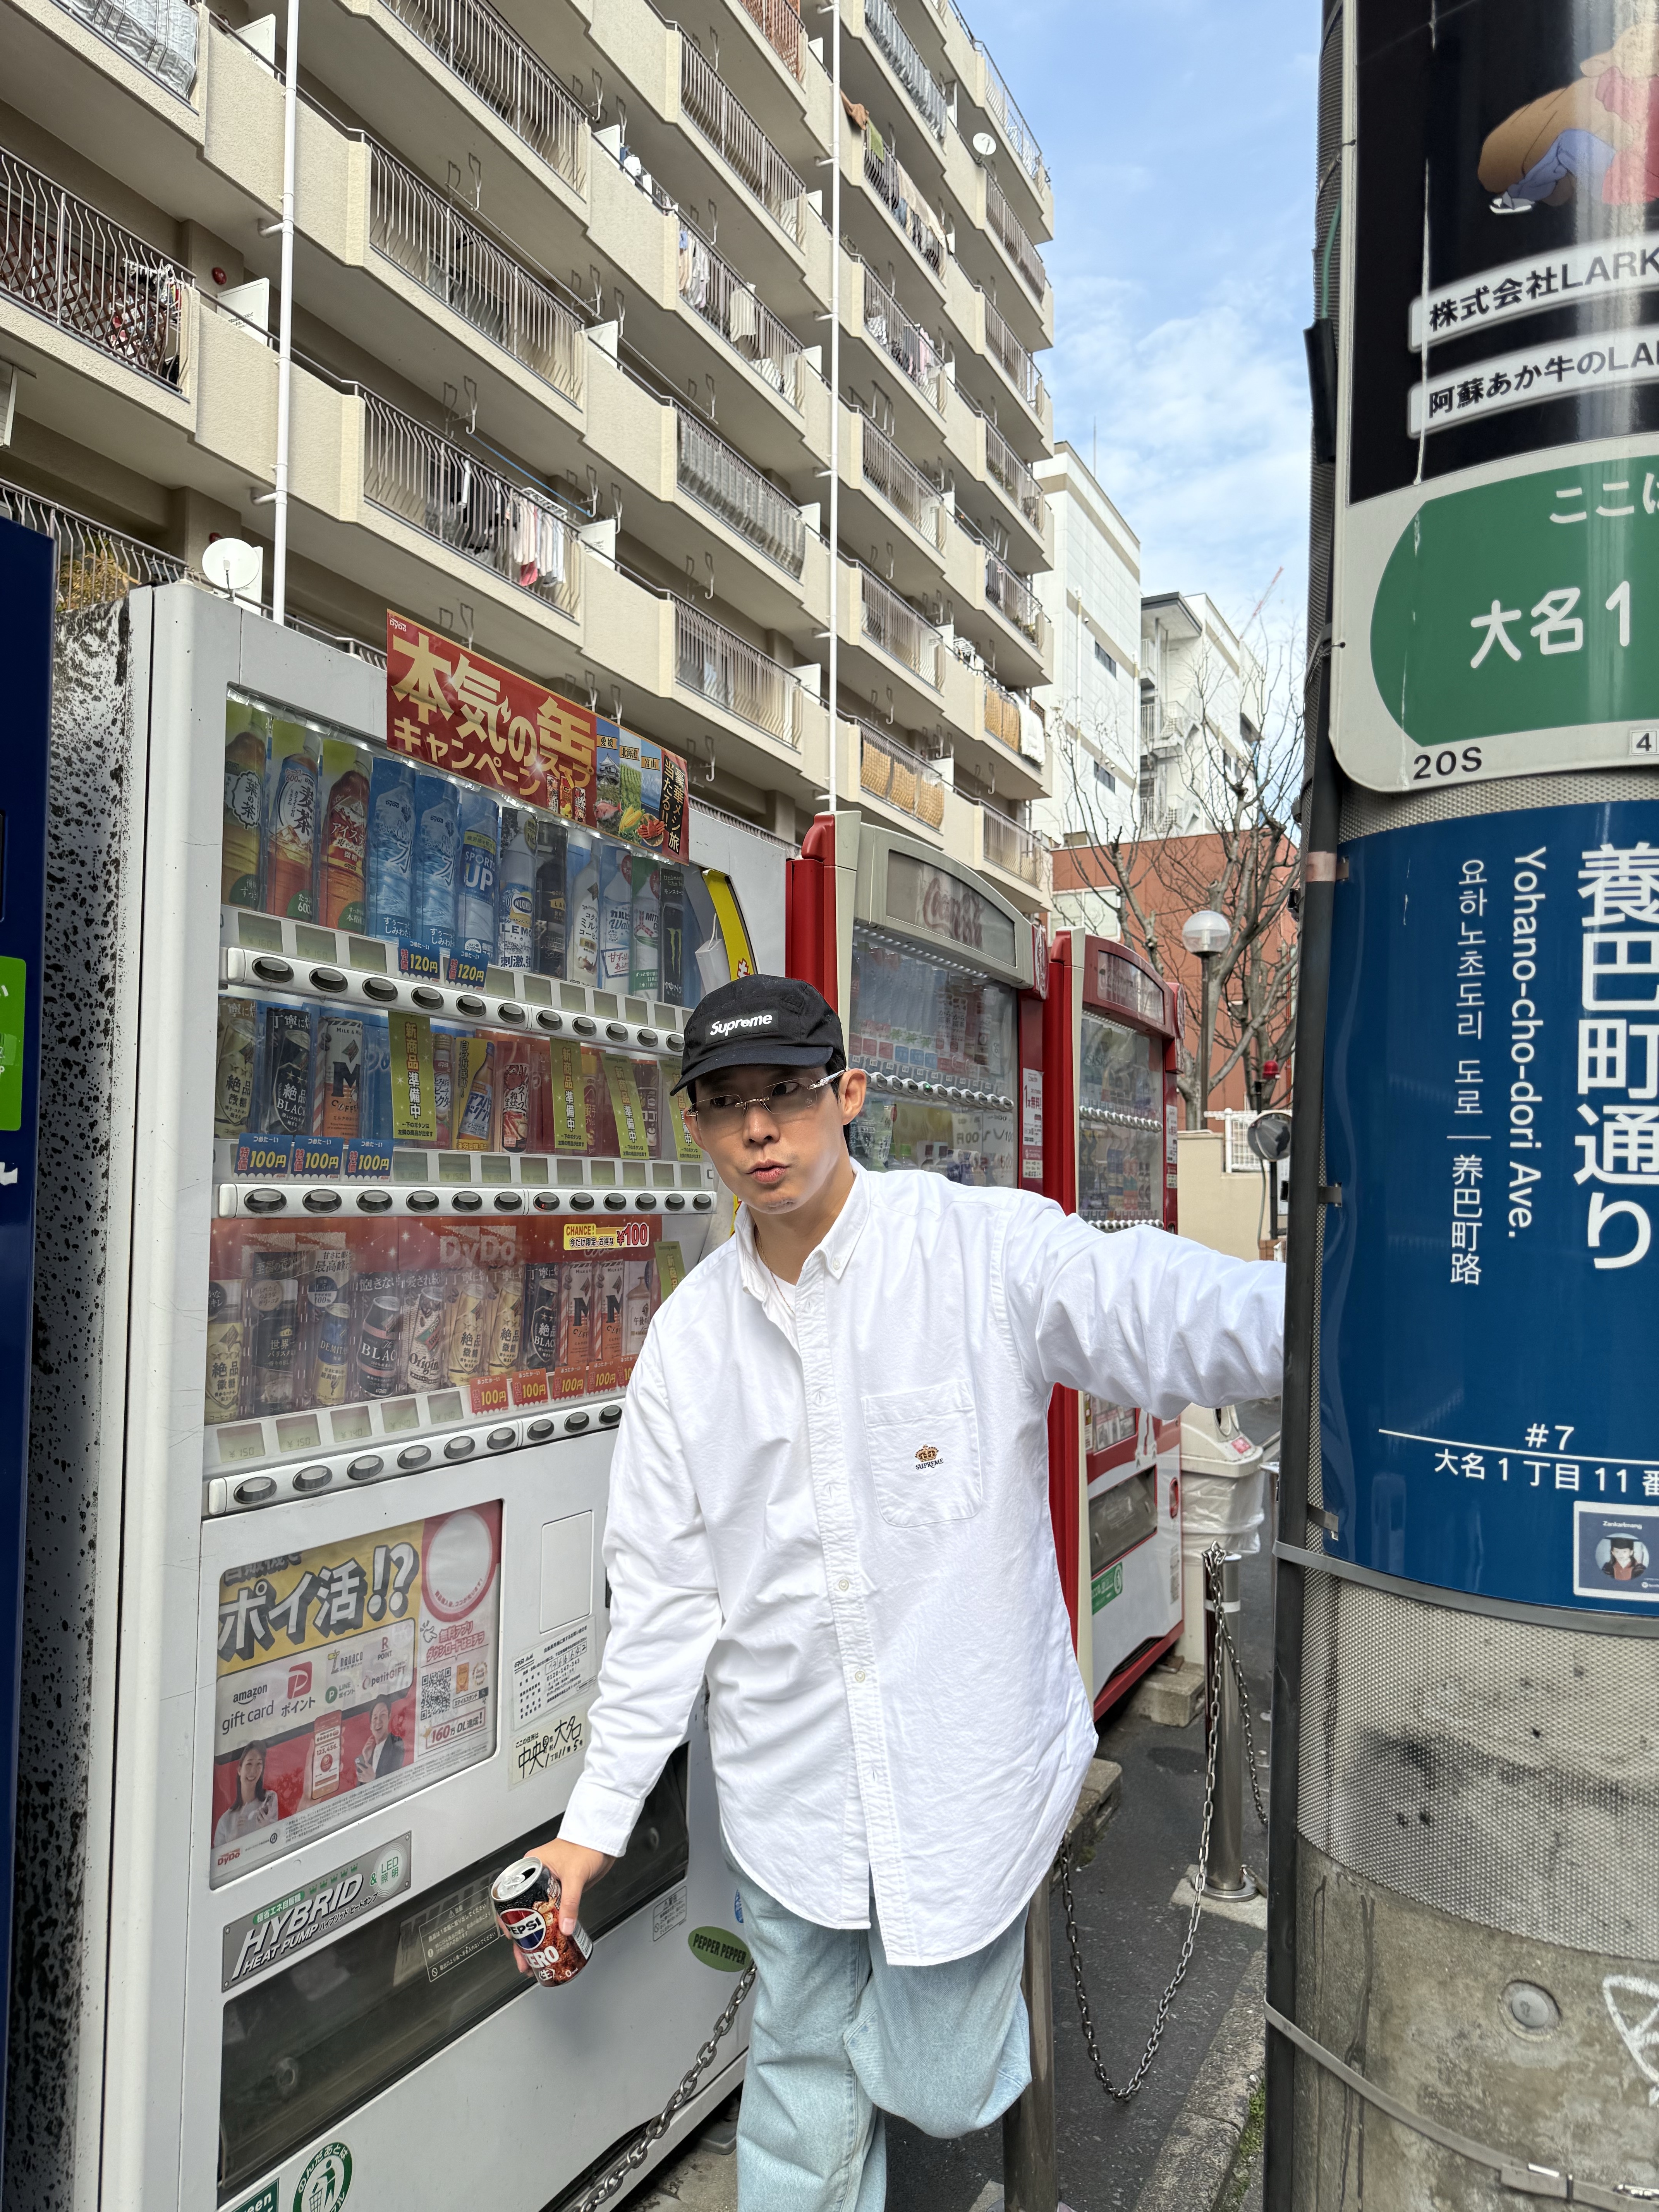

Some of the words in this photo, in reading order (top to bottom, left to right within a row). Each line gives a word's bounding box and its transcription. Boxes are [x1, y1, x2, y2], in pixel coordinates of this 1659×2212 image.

[1428, 340, 1659, 419] 阿蘇あか牛のLA
[390, 617, 407, 632] DyDo
[1470, 580, 1630, 669] 大名1
[392, 632, 595, 770] 本気の缶
[1636, 733, 1652, 752] 4
[394, 717, 540, 796] キャンペーン
[644, 758, 656, 768] 富山
[1413, 746, 1482, 780] 20S
[385, 799, 400, 809] DyDo
[430, 815, 443, 824] DyDo
[465, 863, 493, 891] UP
[1456, 859, 1487, 1041] 요하노초도리
[410, 954, 438, 973] 120円
[458, 964, 484, 982] 120円
[1509, 847, 1546, 1149] Yohano-cho-dori
[710, 1014, 773, 1036] Supreme
[1574, 841, 1659, 1270] 養巴町通り
[405, 1021, 422, 1120] 新商品準備中
[562, 1047, 575, 1132] 新商品準備中
[1454, 1059, 1484, 1115] 도로
[614, 1066, 637, 1144] 新商品準備中
[250, 1151, 286, 1168] 100円
[306, 1152, 338, 1169] 100円
[359, 1155, 389, 1171] 100円
[1508, 1161, 1542, 1238] Ave.
[566, 1225, 594, 1236] CHANCE!
[562, 1378, 583, 1393] 100円
[596, 1372, 616, 1387] 100円
[481, 1389, 507, 1406] 100円
[522, 1383, 546, 1399] 100円
[1525, 1423, 1574, 1450] #7
[915, 1458, 944, 1470] SUPREME
[219, 1542, 418, 1656] ポイ活!?
[340, 1651, 363, 1667] nanaco
[378, 1650, 392, 1660] POINT
[371, 1665, 406, 1687] petitGIFT
[233, 1684, 268, 1704] amazon
[338, 1688, 355, 1698] ポイント
[339, 1682, 351, 1691] LINE
[222, 1712, 245, 1735] gift
[247, 1700, 274, 1722] card
[281, 1697, 316, 1718] ポイント
[553, 1715, 582, 1749] 大名
[217, 1848, 240, 1866] DyDo
[381, 1856, 399, 1874] LED
[369, 1872, 378, 1887] &
[381, 1869, 399, 1886] 照明
[231, 1873, 364, 1980] HYBRID
[244, 1948, 278, 1974] HEAT
[280, 1925, 319, 1956] PUMP
[692, 1933, 720, 1956] PEPPER
[720, 1943, 747, 1965] PEPPER
